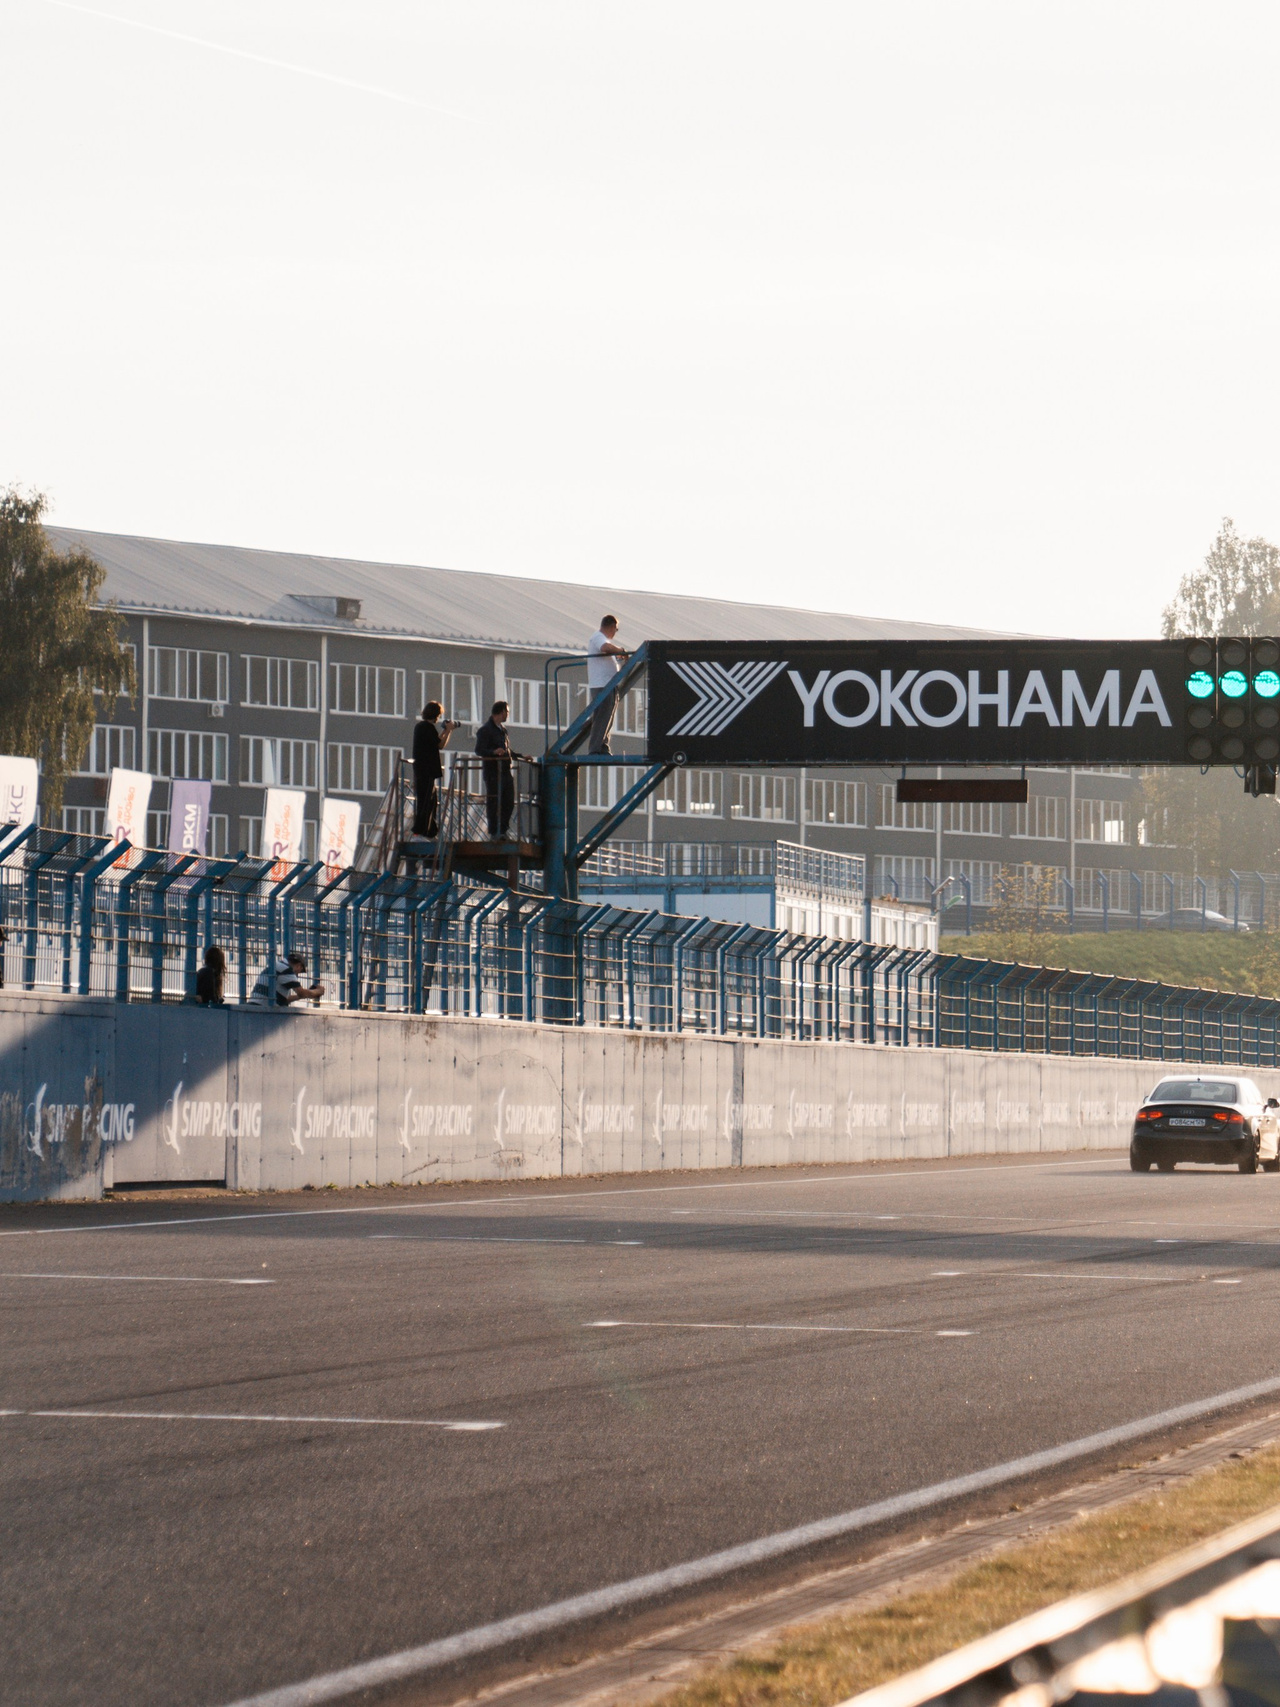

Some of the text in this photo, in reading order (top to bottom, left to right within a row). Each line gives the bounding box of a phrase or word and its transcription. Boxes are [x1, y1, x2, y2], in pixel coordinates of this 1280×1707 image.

[787, 668, 1172, 728] YOKOHAMA
[182, 803, 197, 849] DKM
[81, 1103, 135, 1141] RCING
[181, 1101, 262, 1138] SMP RACING
[305, 1104, 375, 1138] SMP RACING
[411, 1104, 472, 1137] SMP RACING
[505, 1104, 556, 1135] SMP RACING
[584, 1104, 634, 1133] SMP RACING
